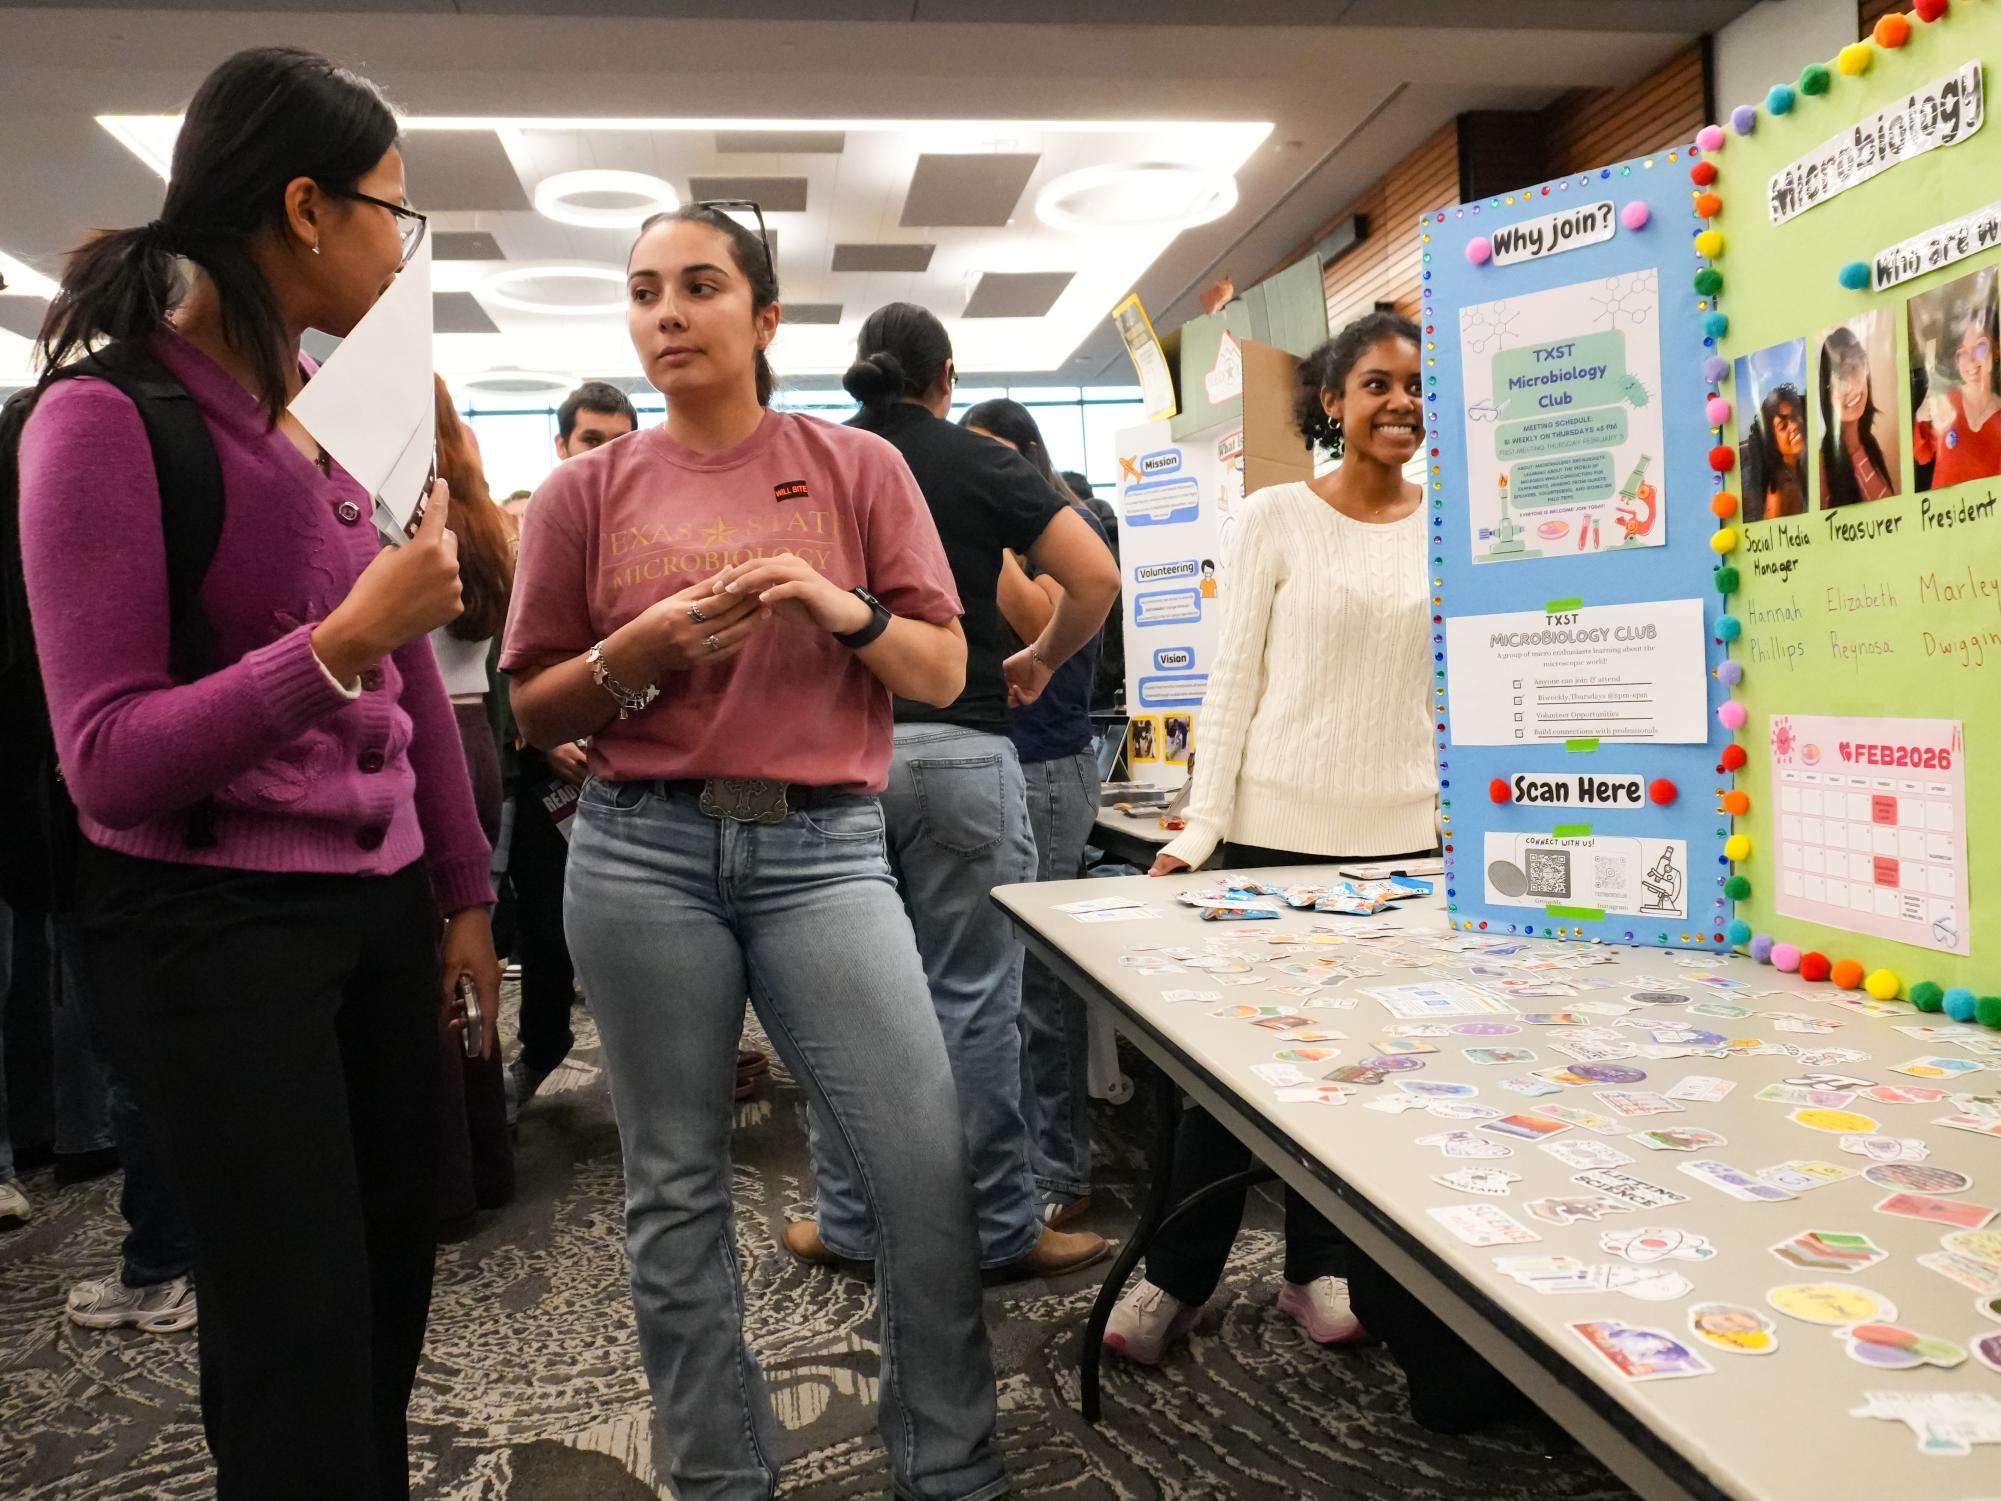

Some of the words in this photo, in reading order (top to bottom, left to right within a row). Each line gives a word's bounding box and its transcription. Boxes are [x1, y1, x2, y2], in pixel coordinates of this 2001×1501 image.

[1494, 227, 1544, 257] Why
[1547, 202, 1613, 252] join?
[1877, 248, 1921, 287] Who
[1928, 226, 1969, 265] are
[1533, 344, 1575, 362] TXST
[1508, 364, 1607, 390] Microbiology
[1538, 392, 1573, 408] Club
[1523, 422, 1554, 432] MEETING
[1555, 416, 1594, 428] SCHEDULE:
[1512, 435, 1538, 444] WEEKLY
[1552, 427, 1594, 438] THURSDAYS
[1547, 440, 1580, 449] THURSDAY
[1582, 435, 1618, 445] FEBRUARY
[1145, 456, 1177, 470] Mission
[776, 487, 792, 497] WILL
[792, 485, 808, 493] BITE
[1921, 491, 1997, 532] President
[1825, 510, 1903, 542] Treasurer
[1745, 526, 1774, 553] Social
[1778, 524, 1811, 548] Media
[1140, 562, 1194, 578] Volunteering
[1754, 558, 1799, 583] Manager
[1826, 583, 1898, 613] Elizabeth
[1919, 565, 2001, 619] Marley
[1546, 613, 1579, 626] TXST
[1749, 595, 1803, 625] Hannah
[1489, 627, 1610, 648] MICROBIOLOGY
[1614, 624, 1657, 642] CLUB
[1160, 654, 1187, 664] Vision
[1503, 652, 1522, 660] group
[1531, 649, 1552, 657] micro
[1552, 647, 1592, 656] enthusiasts
[1593, 646, 1621, 655] learning
[1622, 645, 1642, 653] about
[1644, 644, 1656, 652] the
[1750, 636, 1805, 673] Phillips
[1830, 630, 1894, 674] Reynosa
[1543, 659, 1584, 668] microscopic
[1586, 658, 1607, 666] world!
[1534, 678, 1560, 686] Anyone
[1574, 676, 1588, 685] join
[1597, 675, 1621, 683] attend
[1536, 711, 1569, 719] Volunteer
[1571, 710, 1620, 719] Opportunities
[1534, 728, 1551, 736] Build
[1552, 728, 1593, 736] connections
[1595, 727, 1611, 735] with
[1612, 727, 1658, 736] professionals
[1855, 743, 1952, 770] FEB2026
[1515, 775, 1569, 803] Scan
[1578, 776, 1641, 803] Here
[1525, 837, 1558, 846] CONNECT
[1561, 839, 1580, 847] WITH
[1582, 838, 1595, 848] US!
[1597, 903, 1628, 911] Instagram
[1574, 1175, 1659, 1207] SCIENCE
[1599, 1169, 1686, 1200] LIFTING
